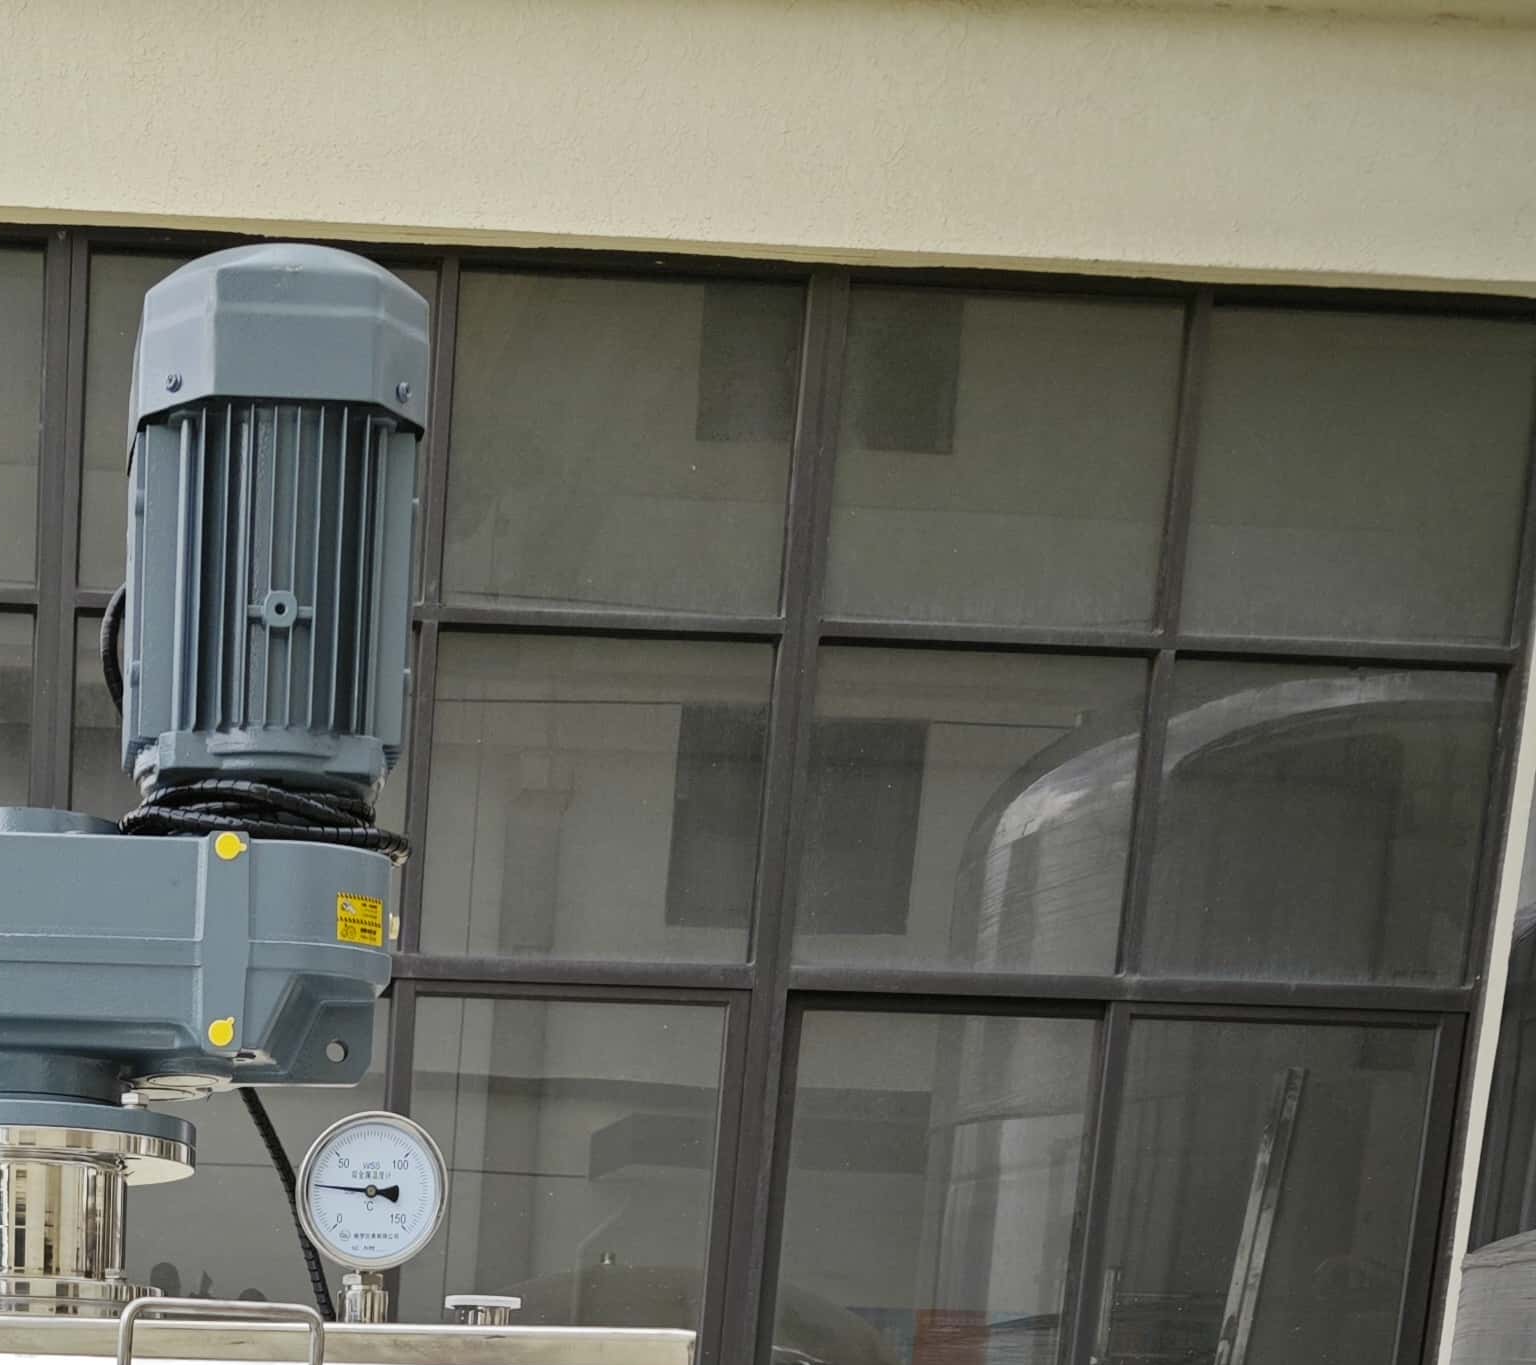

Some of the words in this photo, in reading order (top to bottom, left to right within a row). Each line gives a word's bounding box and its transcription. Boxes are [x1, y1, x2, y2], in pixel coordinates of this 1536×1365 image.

[337, 1158, 350, 1169] 50
[392, 1159, 409, 1170] 100
[336, 1213, 343, 1224] 0
[390, 1214, 406, 1225] 150
